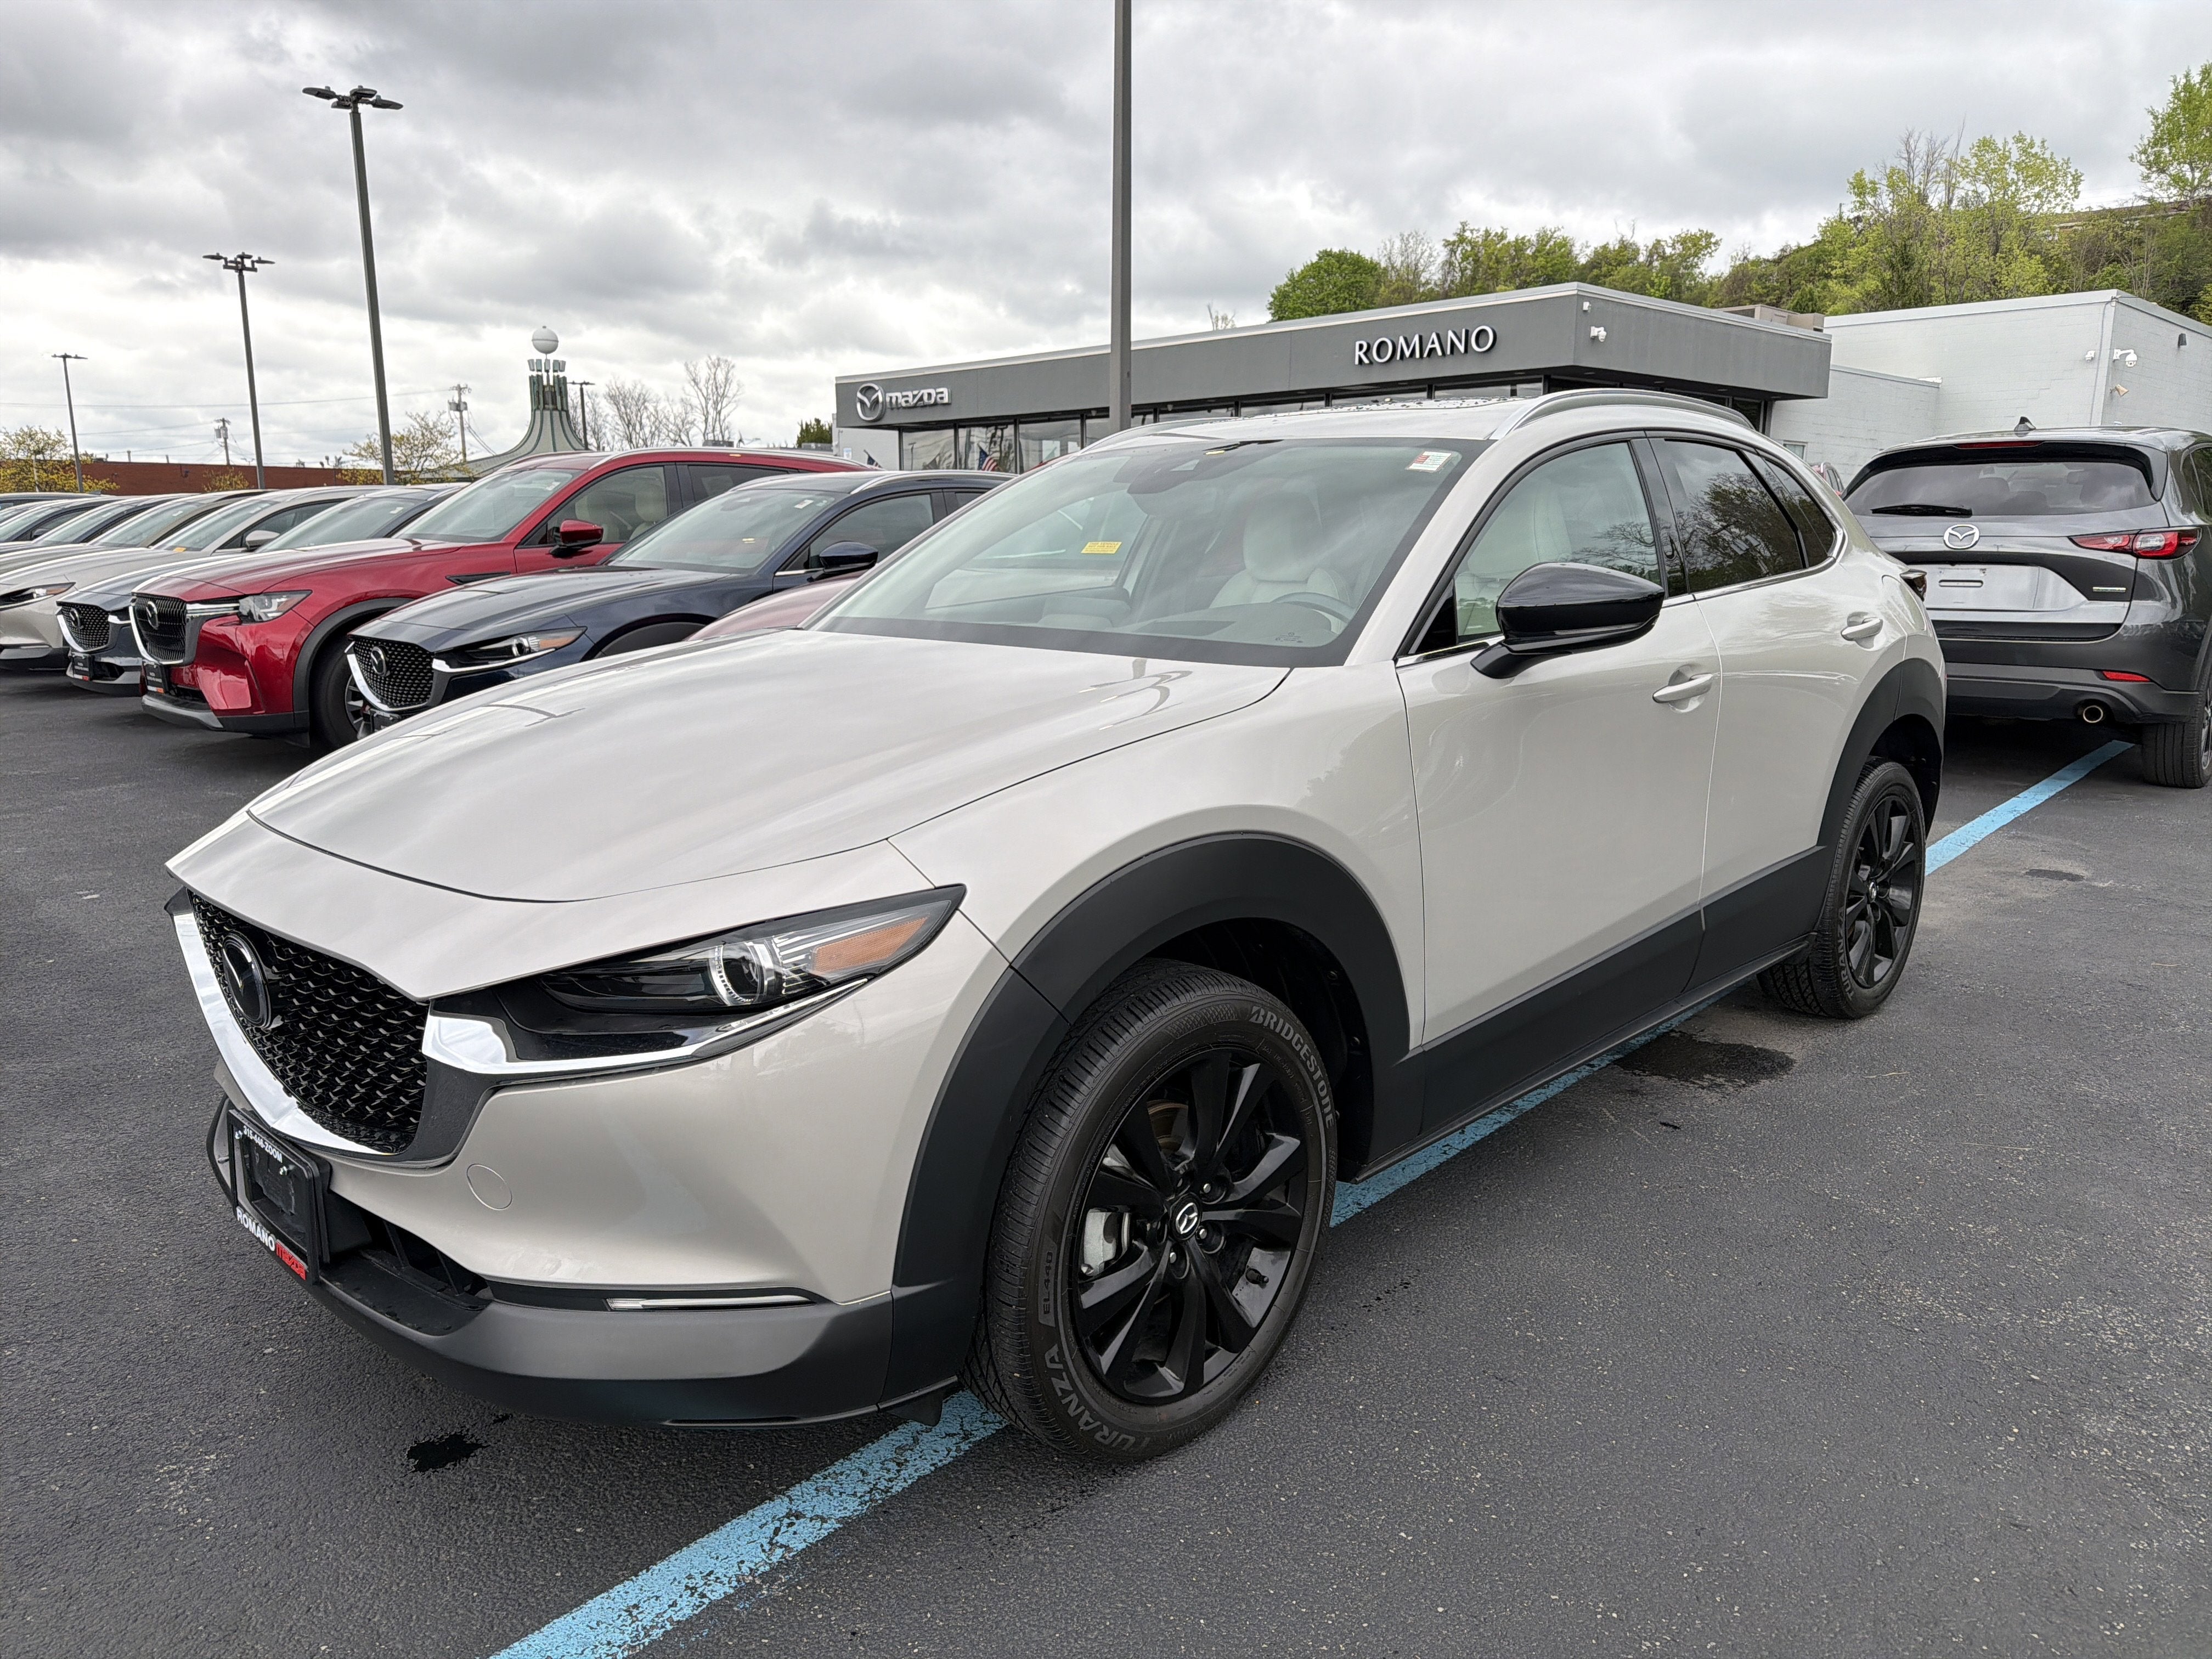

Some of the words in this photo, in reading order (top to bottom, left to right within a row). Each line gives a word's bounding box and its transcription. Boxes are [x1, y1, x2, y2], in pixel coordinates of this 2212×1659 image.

[1355, 325, 1496, 365] ROMANO
[885, 387, 951, 409] mazda
[1249, 1006, 1334, 1129] BRIDGESTONE
[243, 1125, 283, 1164] 315-446-ZOOM
[235, 1206, 276, 1251] ROMANO
[1042, 1251, 1054, 1315] EL440
